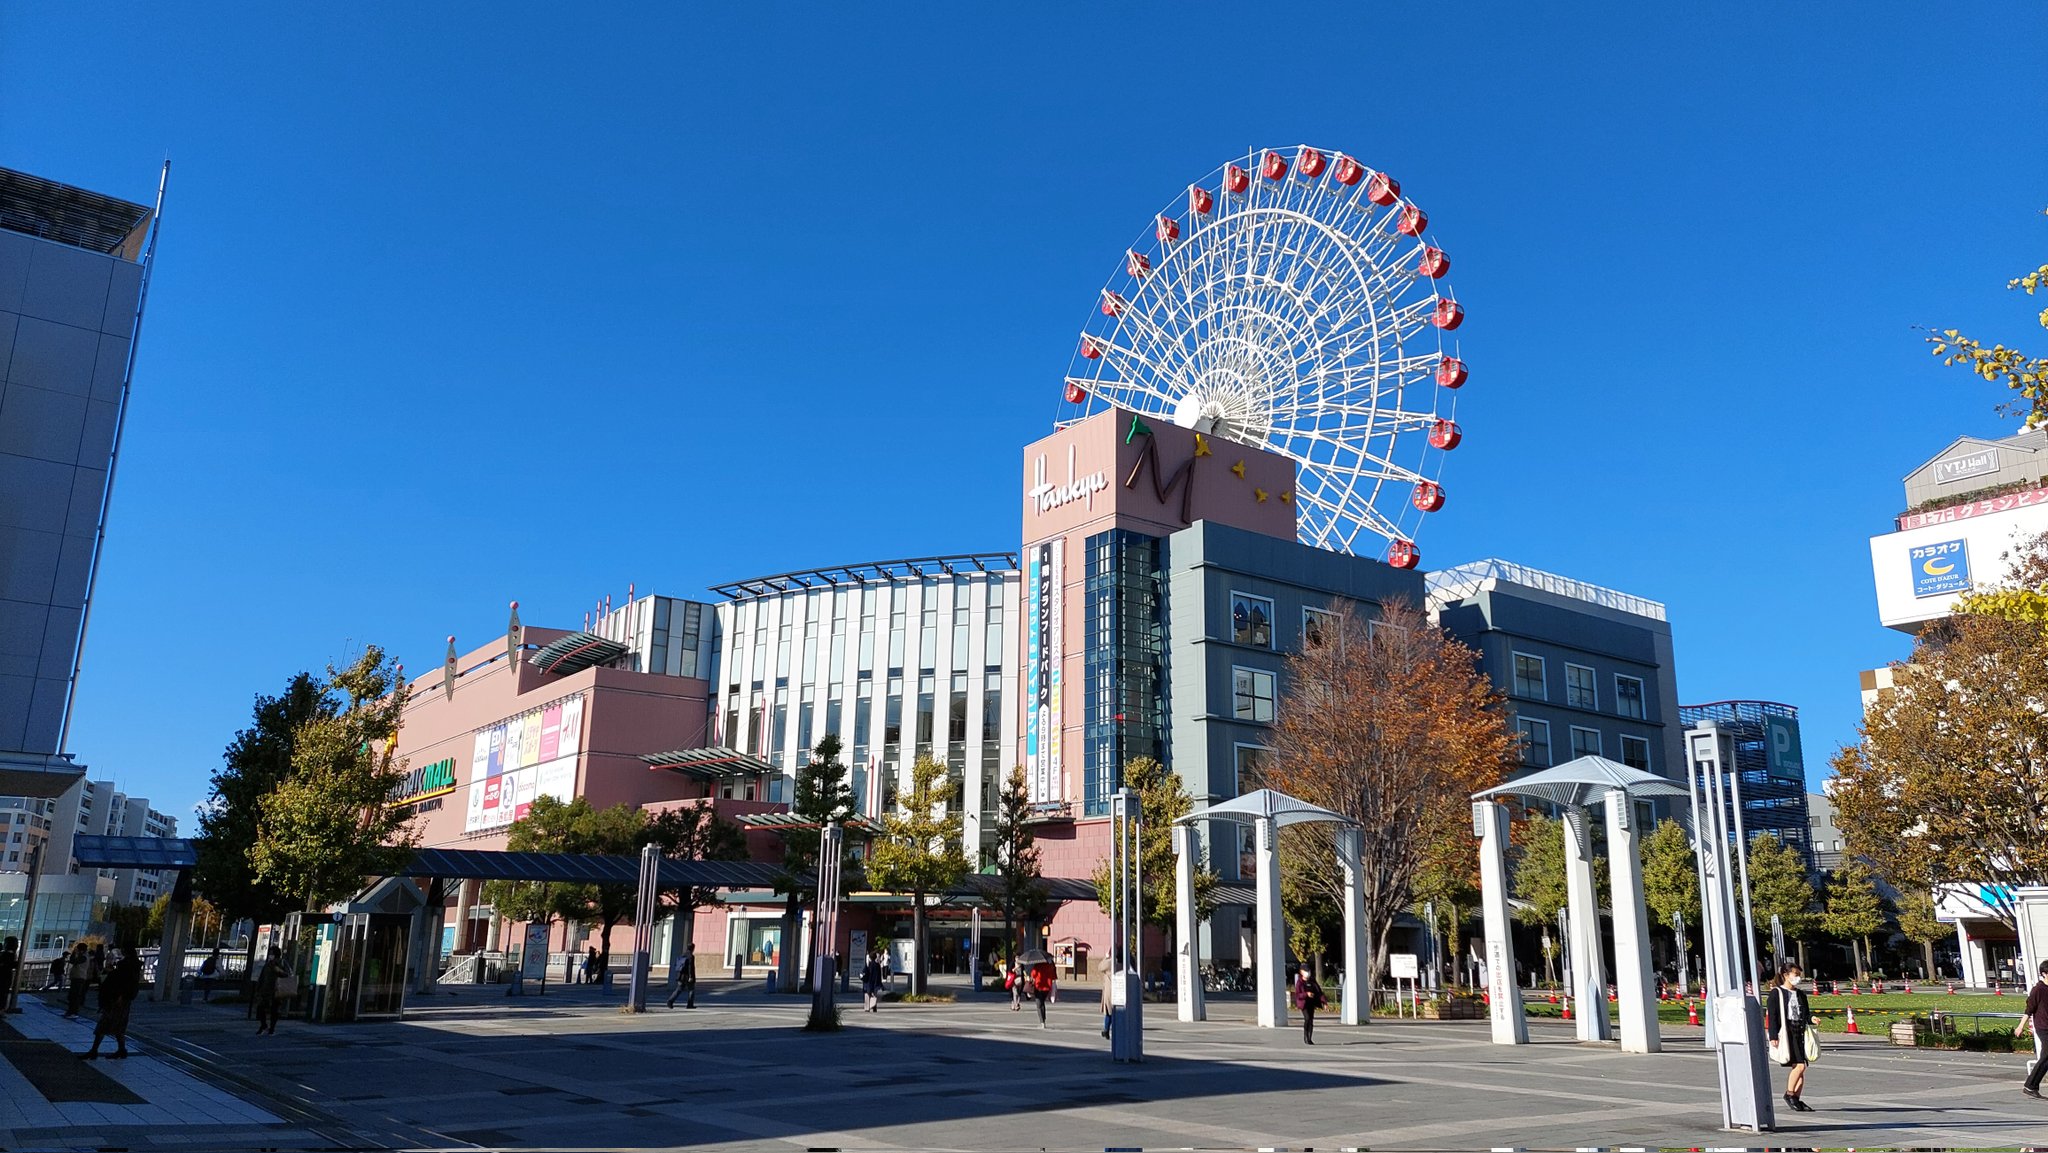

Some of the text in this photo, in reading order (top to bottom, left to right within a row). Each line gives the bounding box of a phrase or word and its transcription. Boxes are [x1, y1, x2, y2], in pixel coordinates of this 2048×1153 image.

[1028, 443, 1109, 517] Hankyu
[1944, 459, 1967, 474] YTJ
[1912, 542, 1960, 560] カラオケ
[1772, 724, 1790, 767] P
